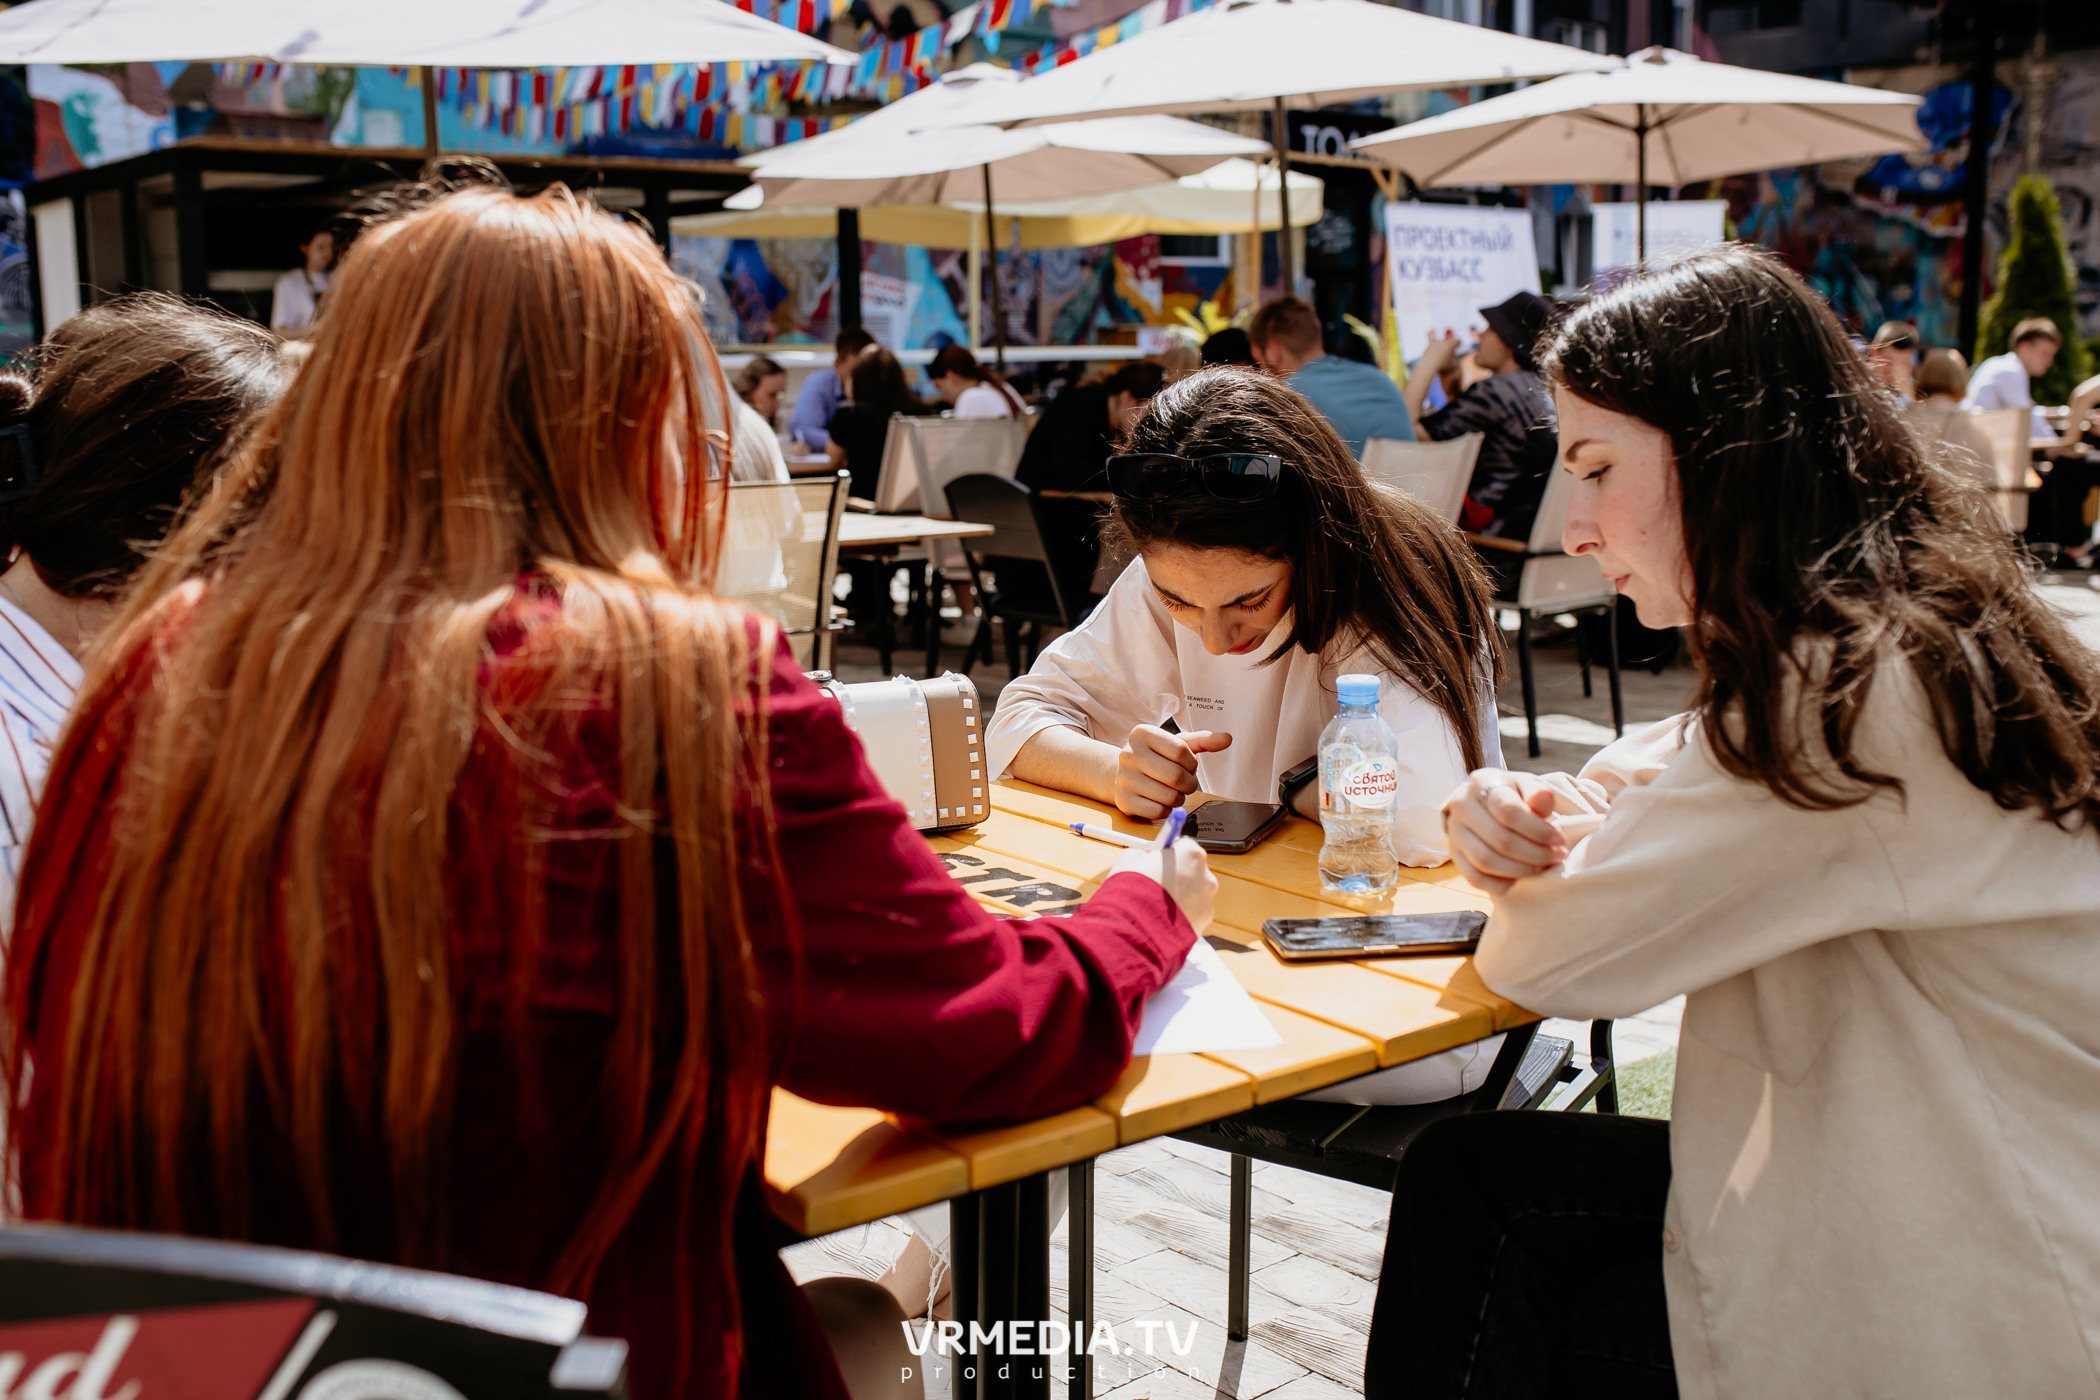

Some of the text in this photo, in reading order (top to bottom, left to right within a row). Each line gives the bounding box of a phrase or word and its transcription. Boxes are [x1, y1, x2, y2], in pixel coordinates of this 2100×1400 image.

[1393, 223, 1514, 251] ПРОЕКТНЫЙ
[1398, 256, 1485, 282] КУЗБАСС
[1187, 695, 1212, 703] SEAWEED
